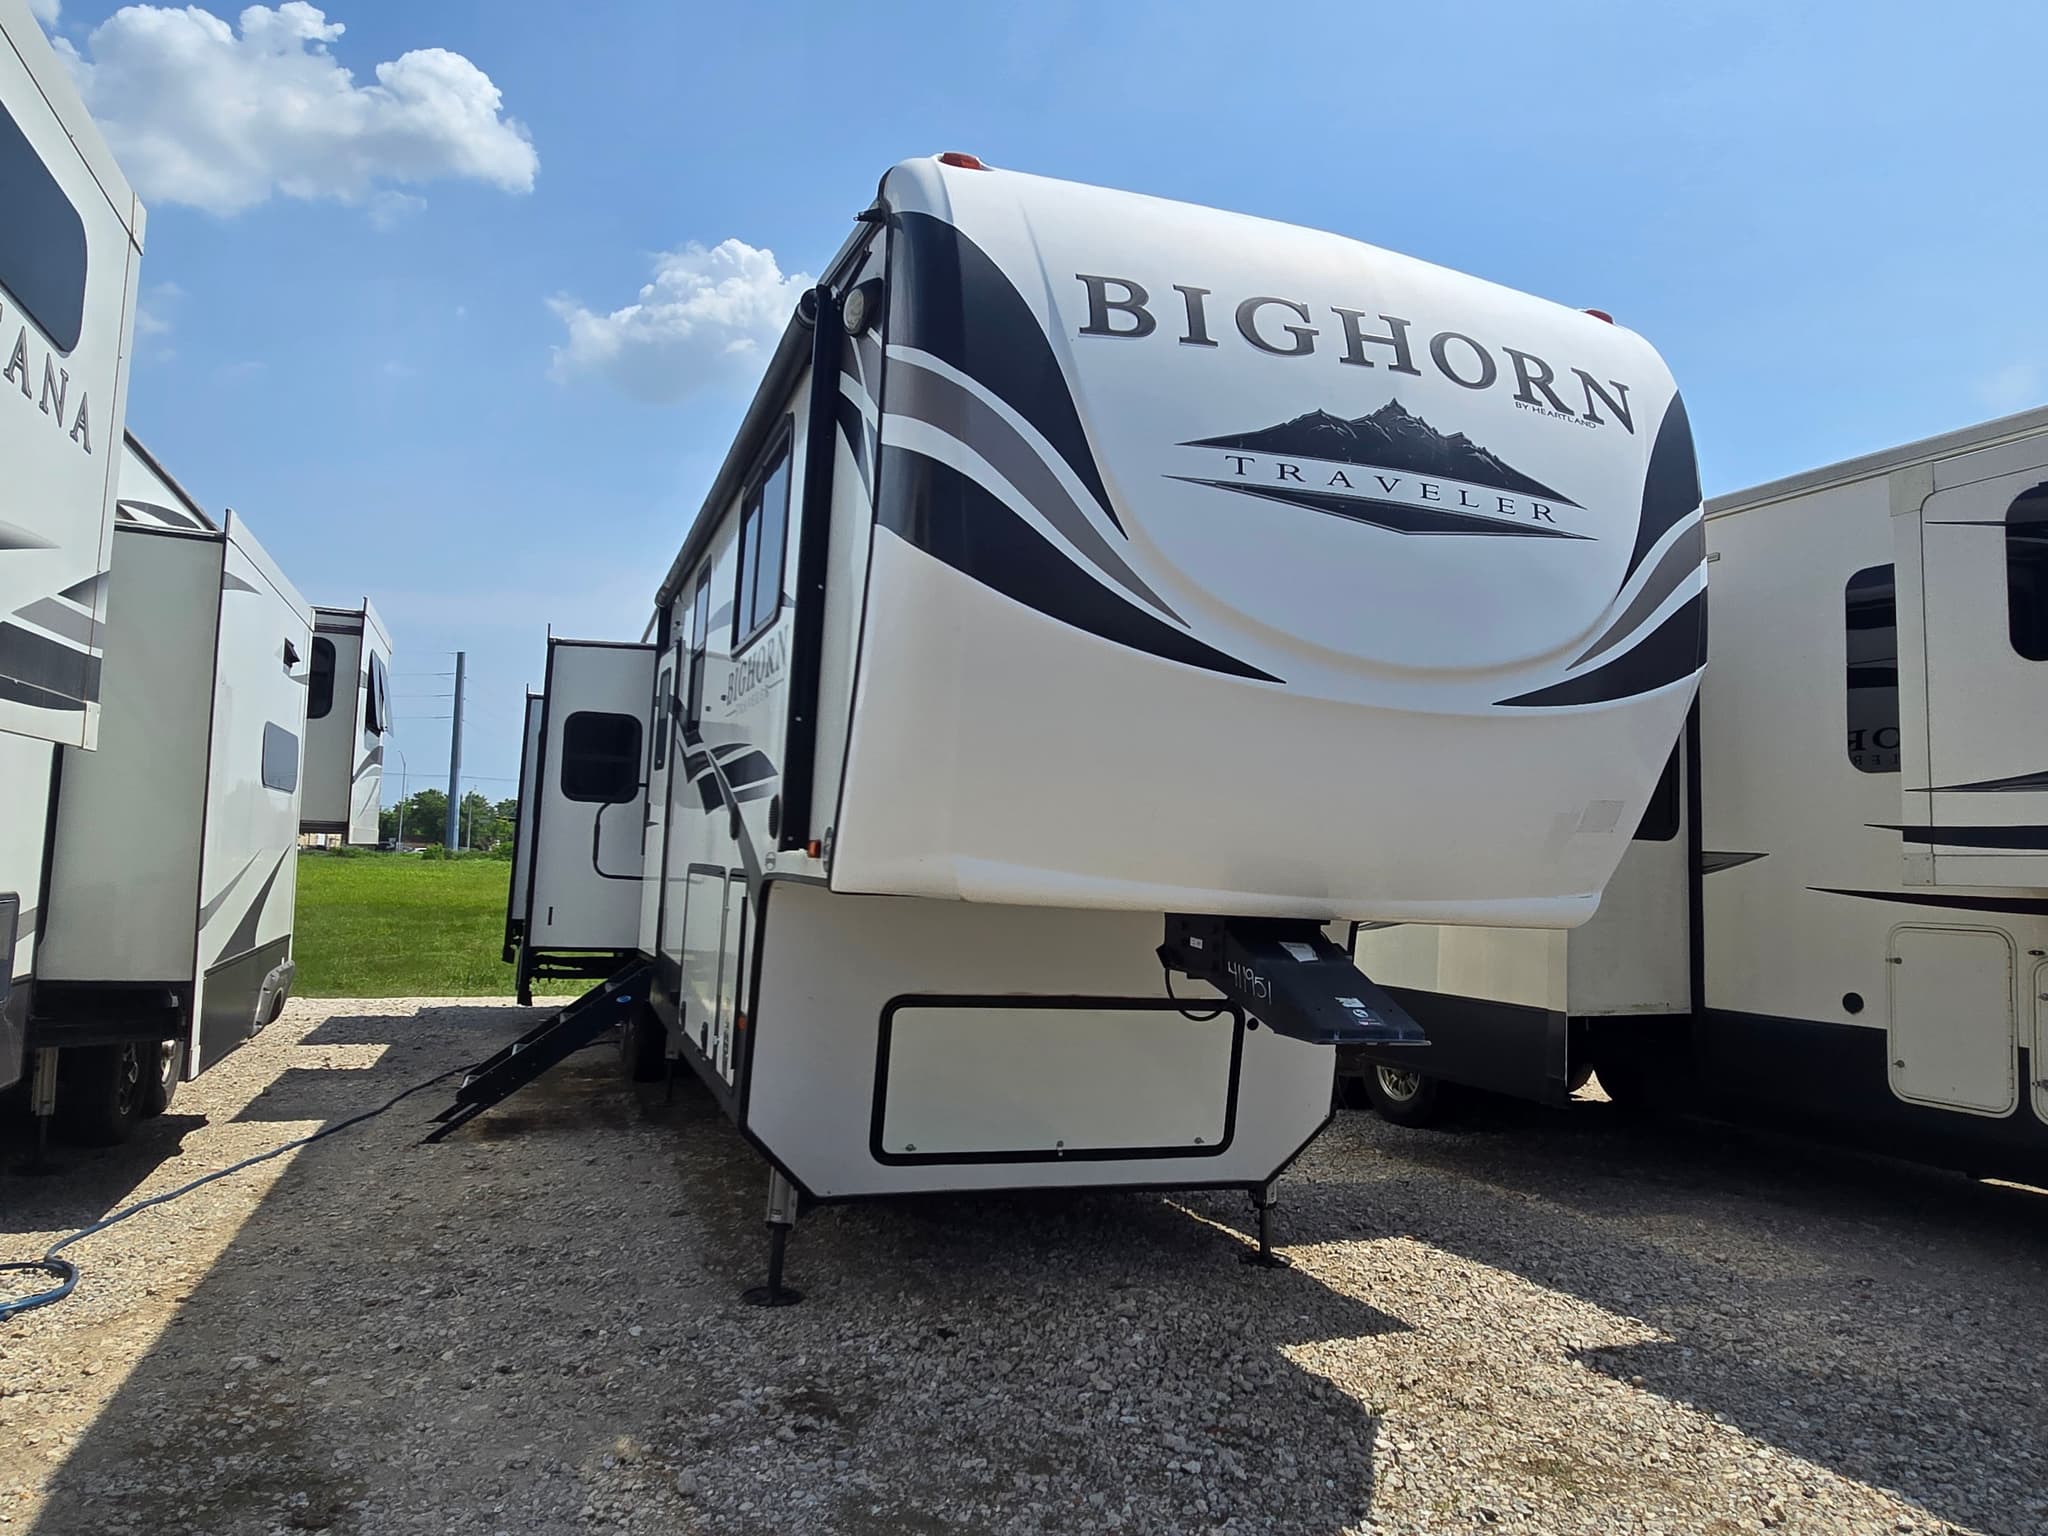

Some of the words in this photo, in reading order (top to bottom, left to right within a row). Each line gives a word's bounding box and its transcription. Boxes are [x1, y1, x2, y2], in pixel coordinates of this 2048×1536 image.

[0, 301, 92, 455] ANA
[1075, 272, 1636, 436] BIGHORN
[1515, 401, 1529, 411] BY
[1532, 405, 1597, 429] HEARTLAND
[1224, 455, 1556, 524] TRAVELER
